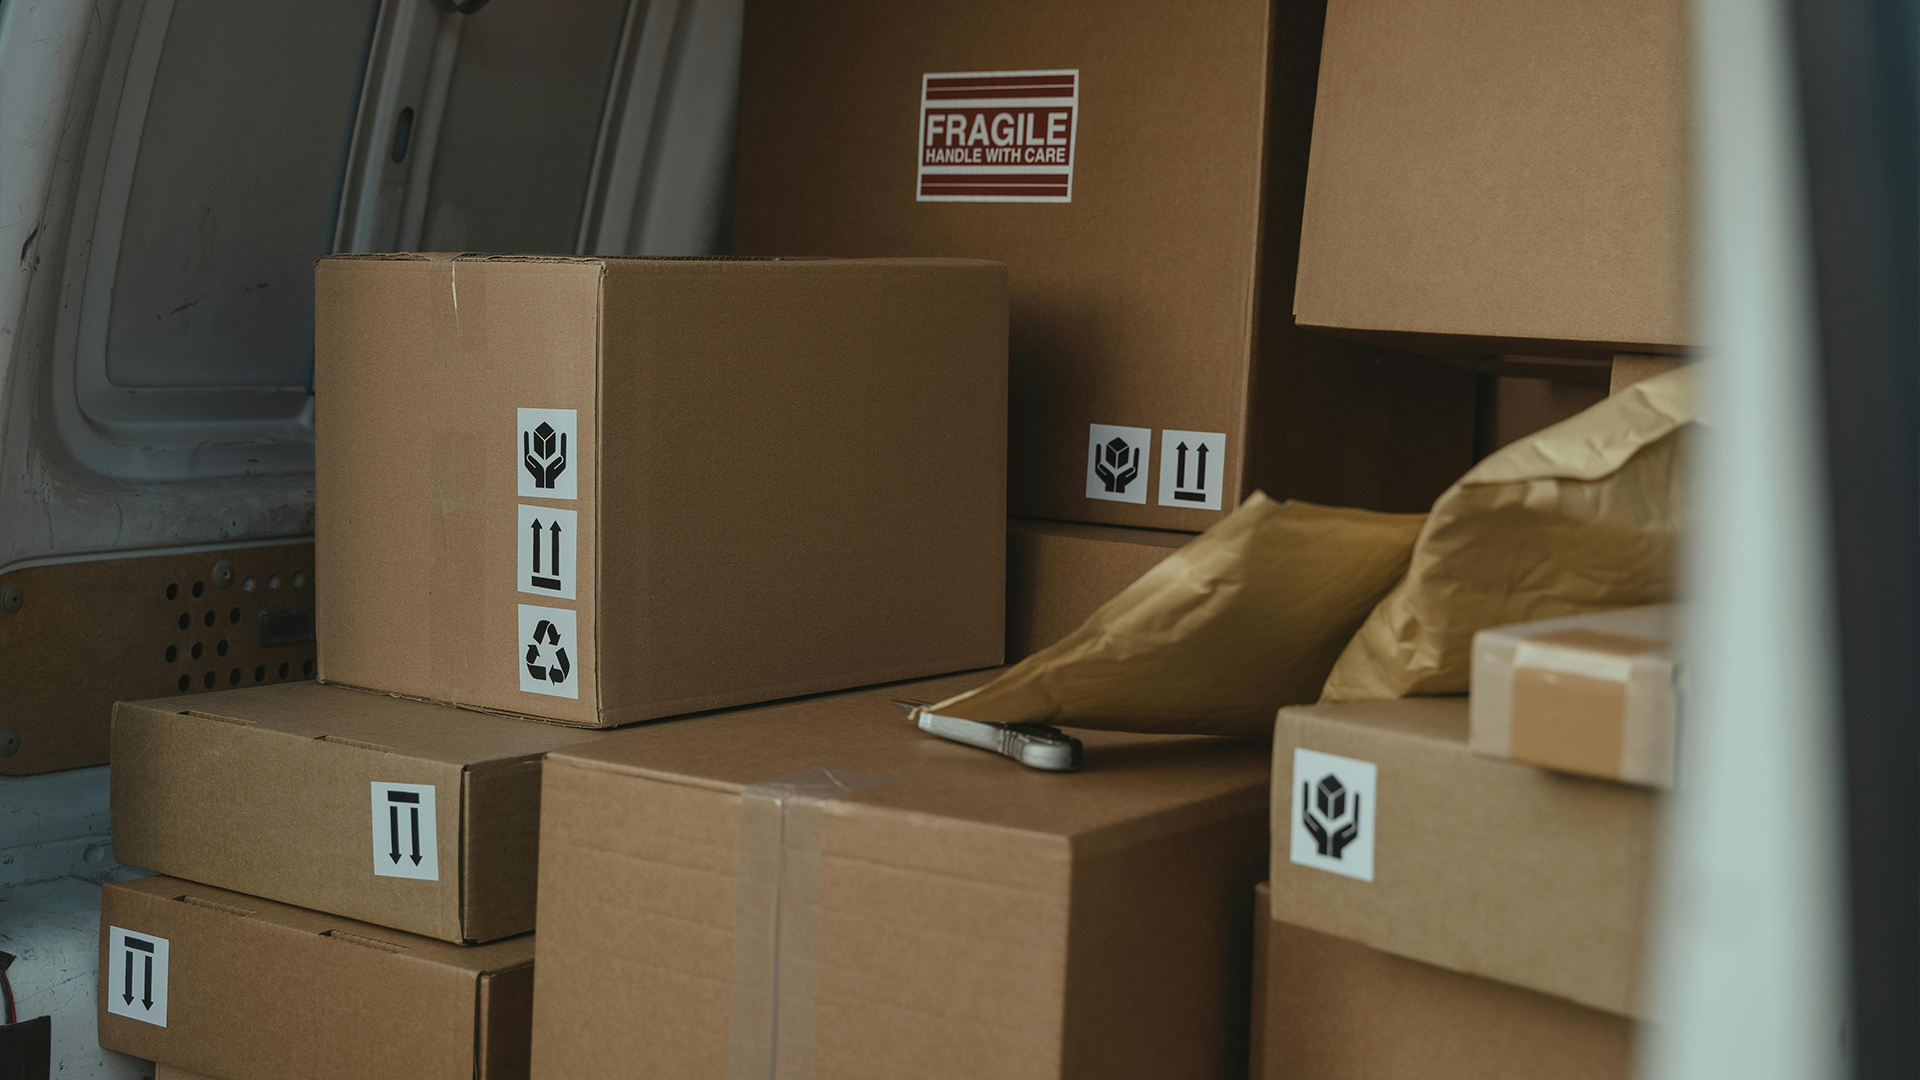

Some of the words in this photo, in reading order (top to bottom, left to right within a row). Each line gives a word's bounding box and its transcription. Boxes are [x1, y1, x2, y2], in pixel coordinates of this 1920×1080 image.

[926, 112, 1068, 147] FRAGILE
[925, 147, 982, 163] HANDLE
[986, 147, 1021, 163] WITH
[1024, 147, 1066, 163] CARE
